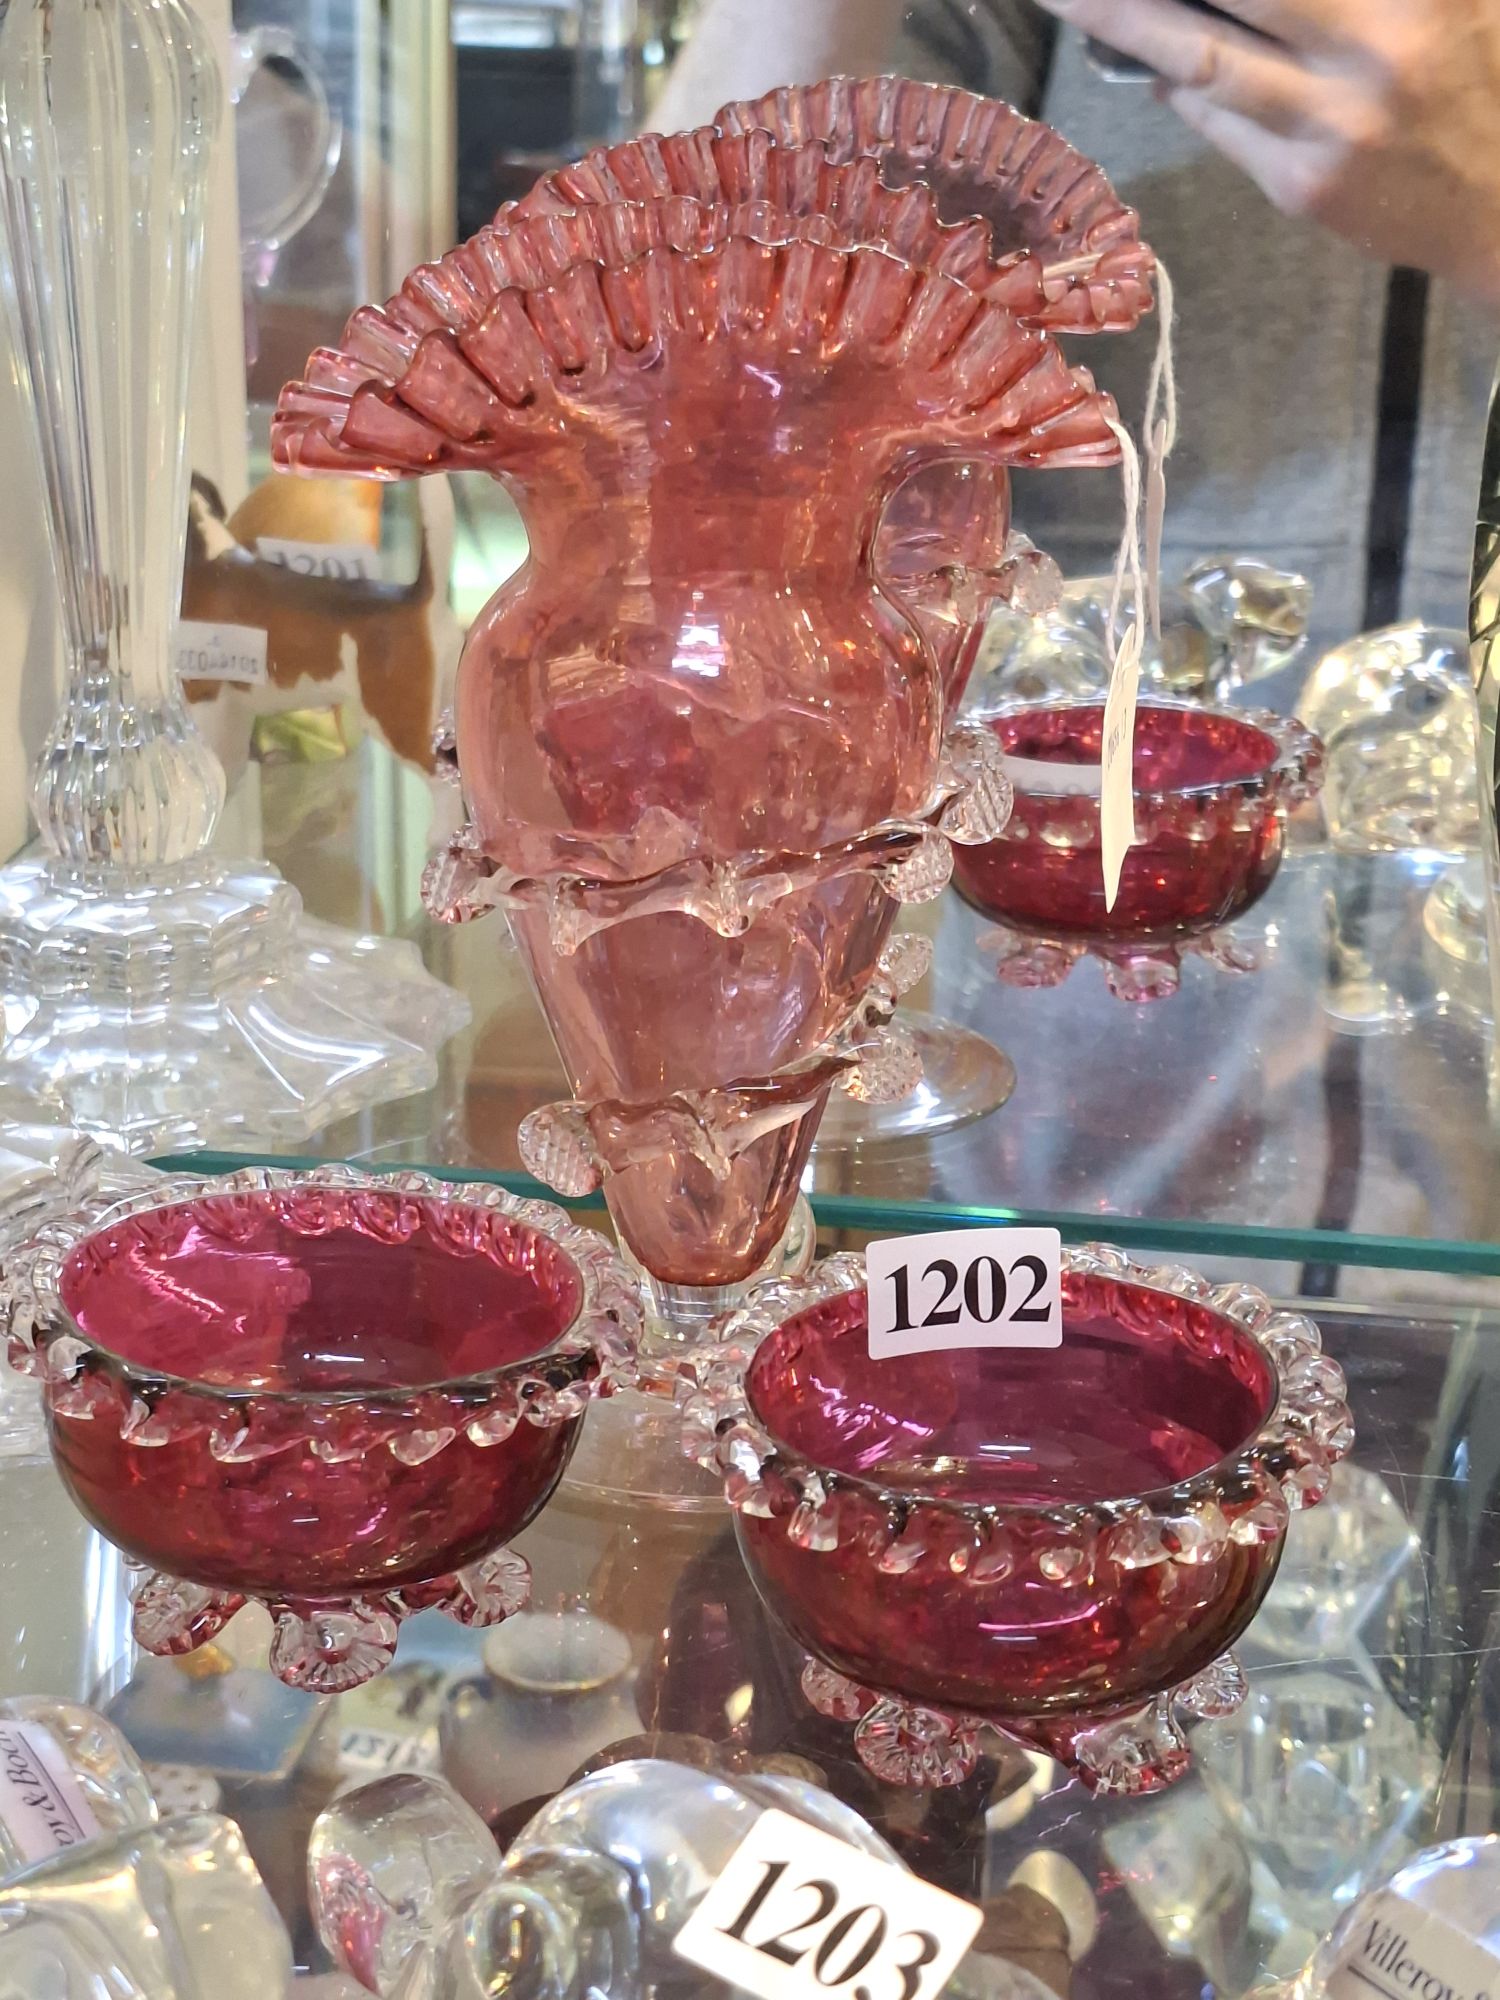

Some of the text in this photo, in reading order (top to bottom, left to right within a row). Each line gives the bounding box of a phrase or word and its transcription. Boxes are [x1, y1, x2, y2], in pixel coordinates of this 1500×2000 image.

[884, 1254, 1052, 1334] 1202
[22, 1790, 56, 1812] &
[715, 1861, 941, 2000] 1203
